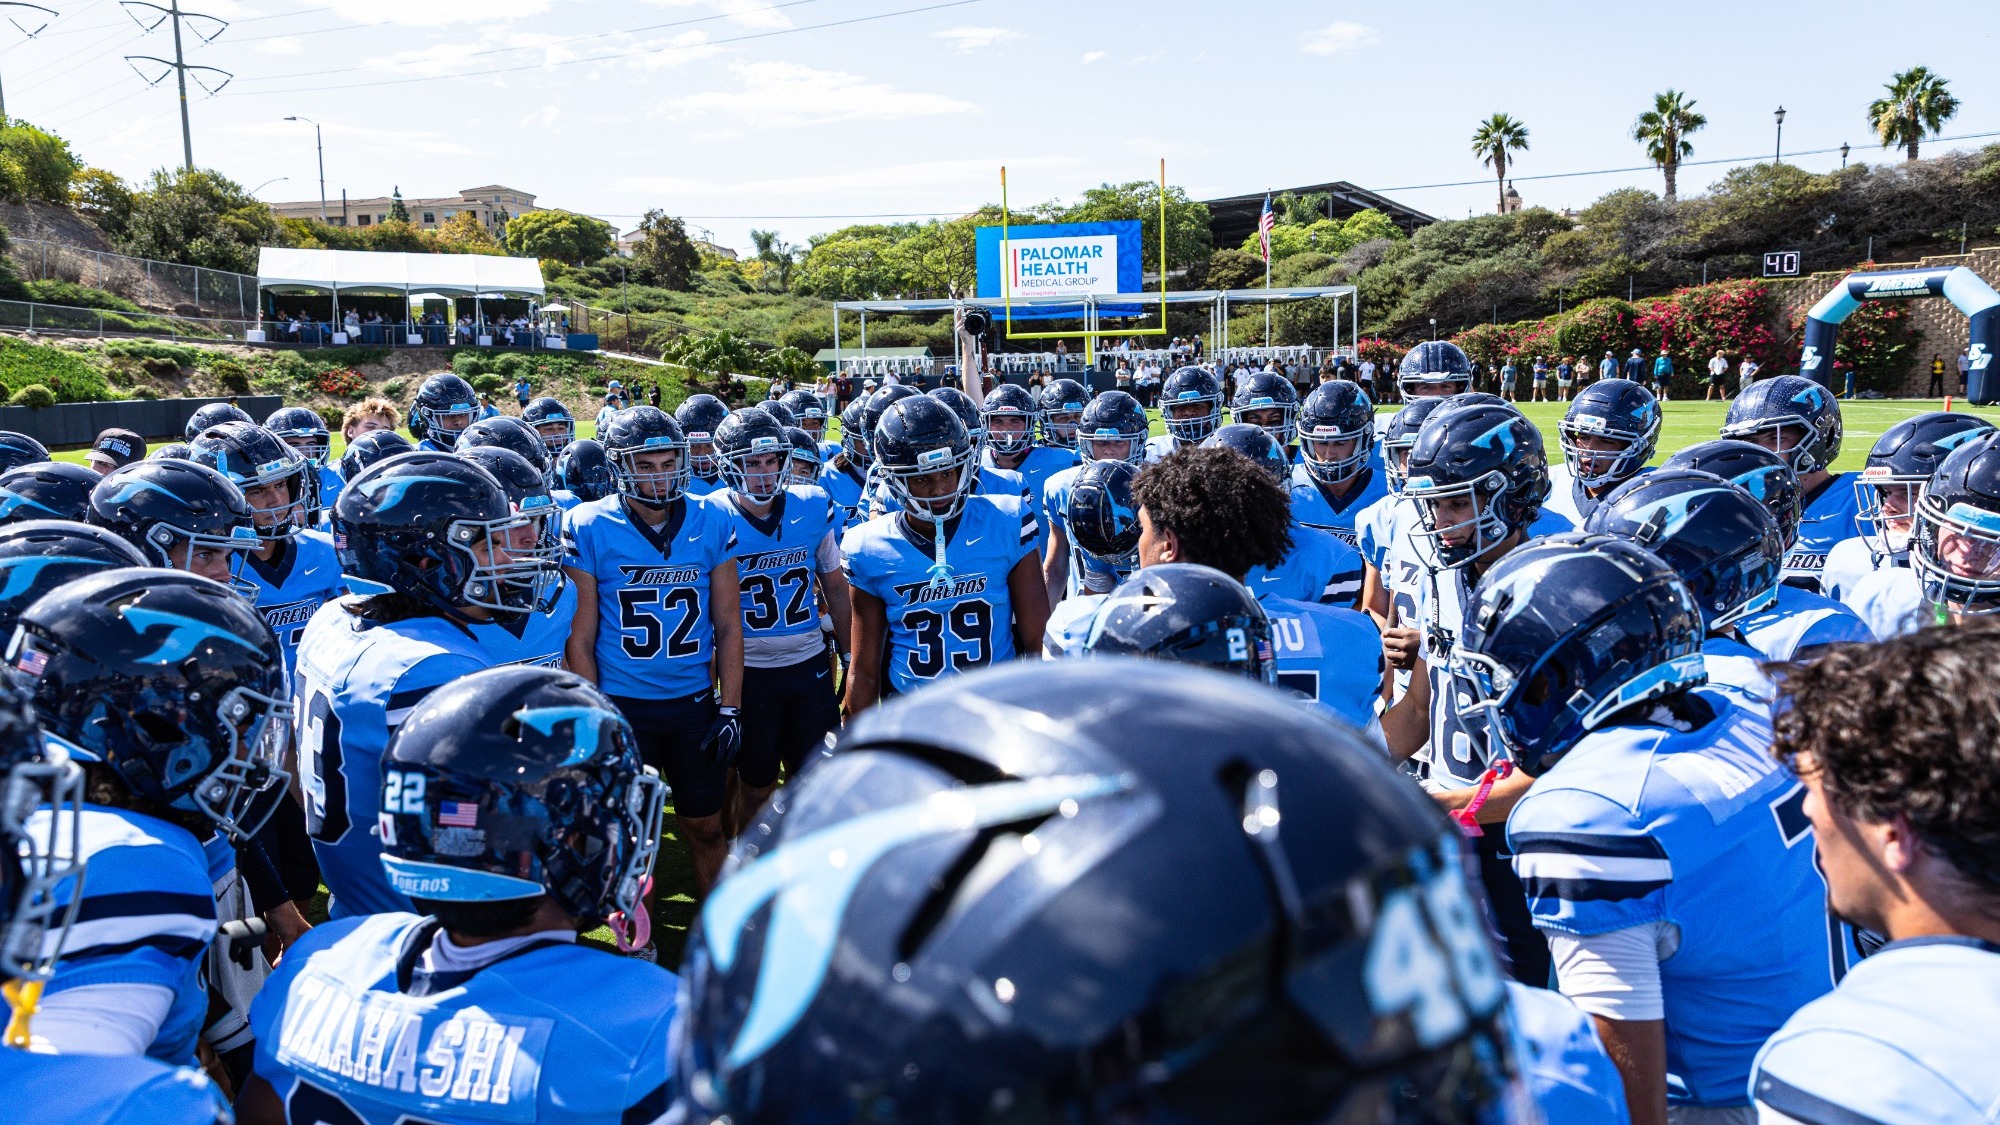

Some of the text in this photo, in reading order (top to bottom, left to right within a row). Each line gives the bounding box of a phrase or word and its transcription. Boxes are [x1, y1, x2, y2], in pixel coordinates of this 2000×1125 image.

[1021, 245, 1103, 261] PALOMAR
[1766, 253, 1797, 273] 40
[1021, 261, 1088, 277] HEALTH
[1021, 278, 1063, 288] MEDICAL
[111, 441, 131, 457] DIEGO
[737, 547, 808, 572] TOREROS
[619, 564, 700, 586] TOREROS
[739, 566, 813, 632] 32
[616, 586, 702, 660] 52
[900, 597, 994, 682] 39
[384, 770, 426, 815] 22
[279, 976, 528, 1105] TAKAHASHI
